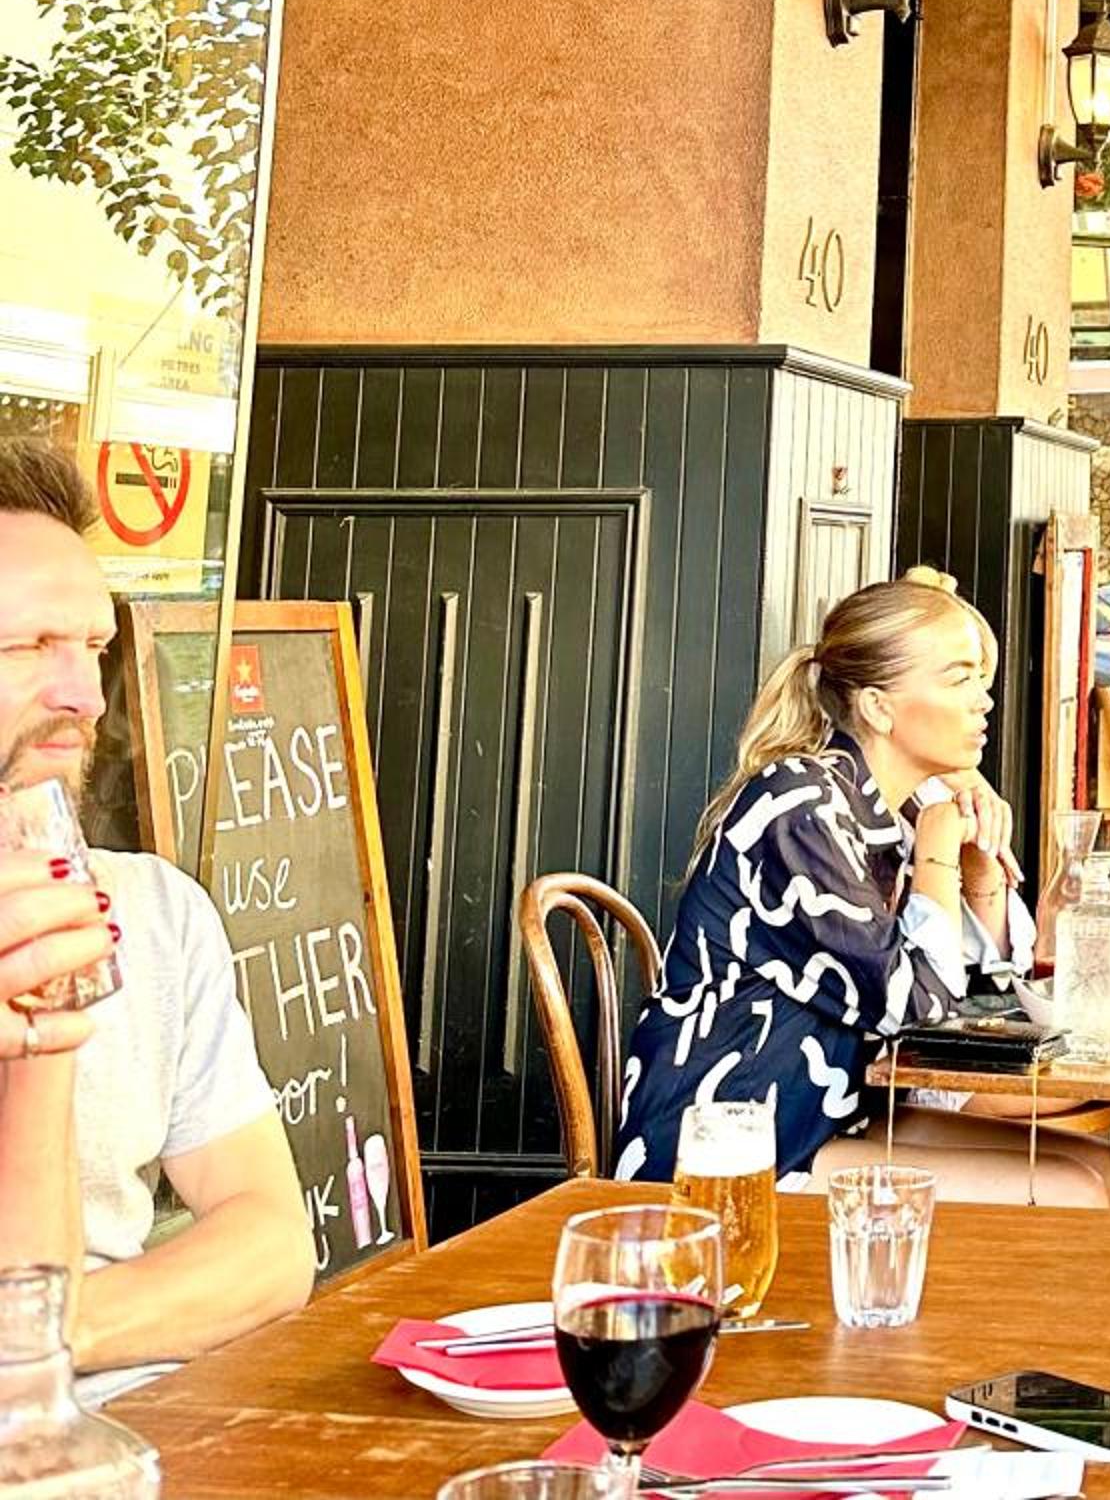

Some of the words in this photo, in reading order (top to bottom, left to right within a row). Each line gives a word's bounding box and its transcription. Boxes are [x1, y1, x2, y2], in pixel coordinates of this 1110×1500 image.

[798, 216, 845, 313] 40
[1023, 315, 1049, 386] 40
[223, 857, 298, 915] use
[231, 921, 377, 1042] THER
